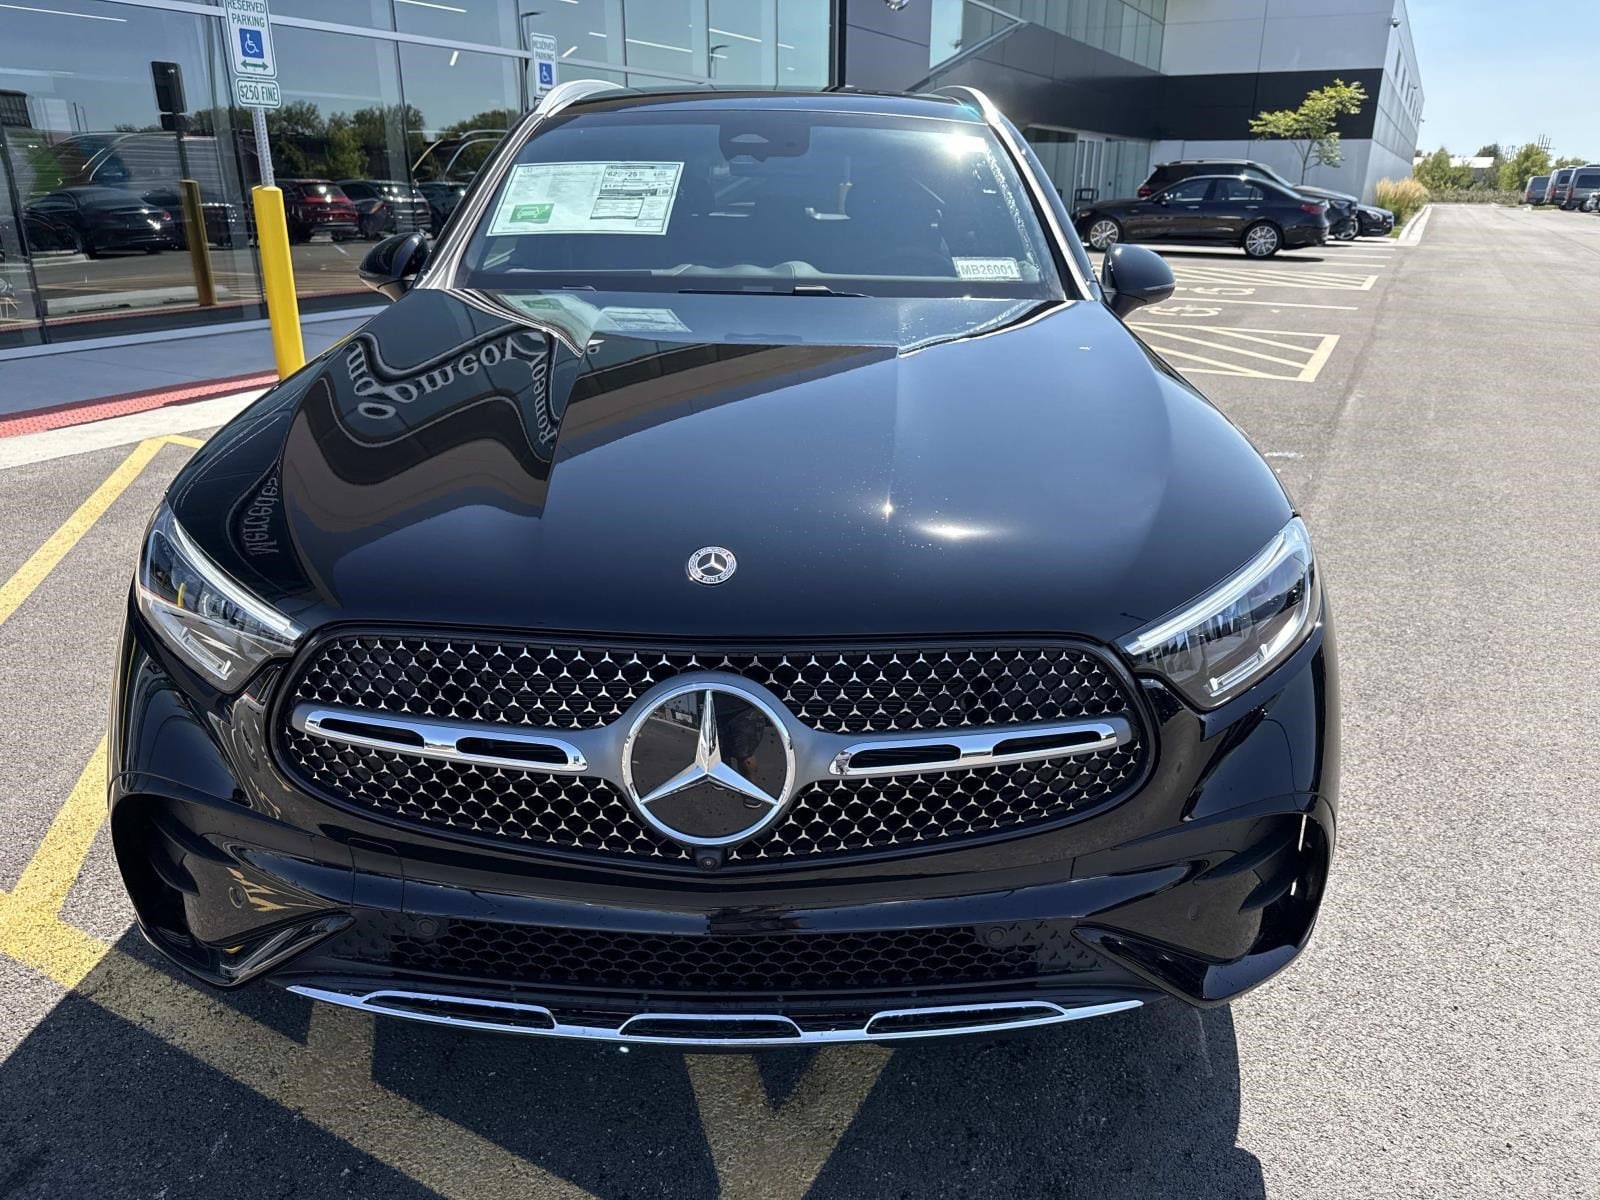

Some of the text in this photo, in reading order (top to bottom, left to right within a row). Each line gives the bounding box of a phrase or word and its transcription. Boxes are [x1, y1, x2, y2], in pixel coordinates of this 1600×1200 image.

[227, 0, 265, 13] RESERVED
[231, 13, 265, 28] PARKING
[239, 84, 278, 102] $250 FINE
[960, 264, 1015, 275] MB26001
